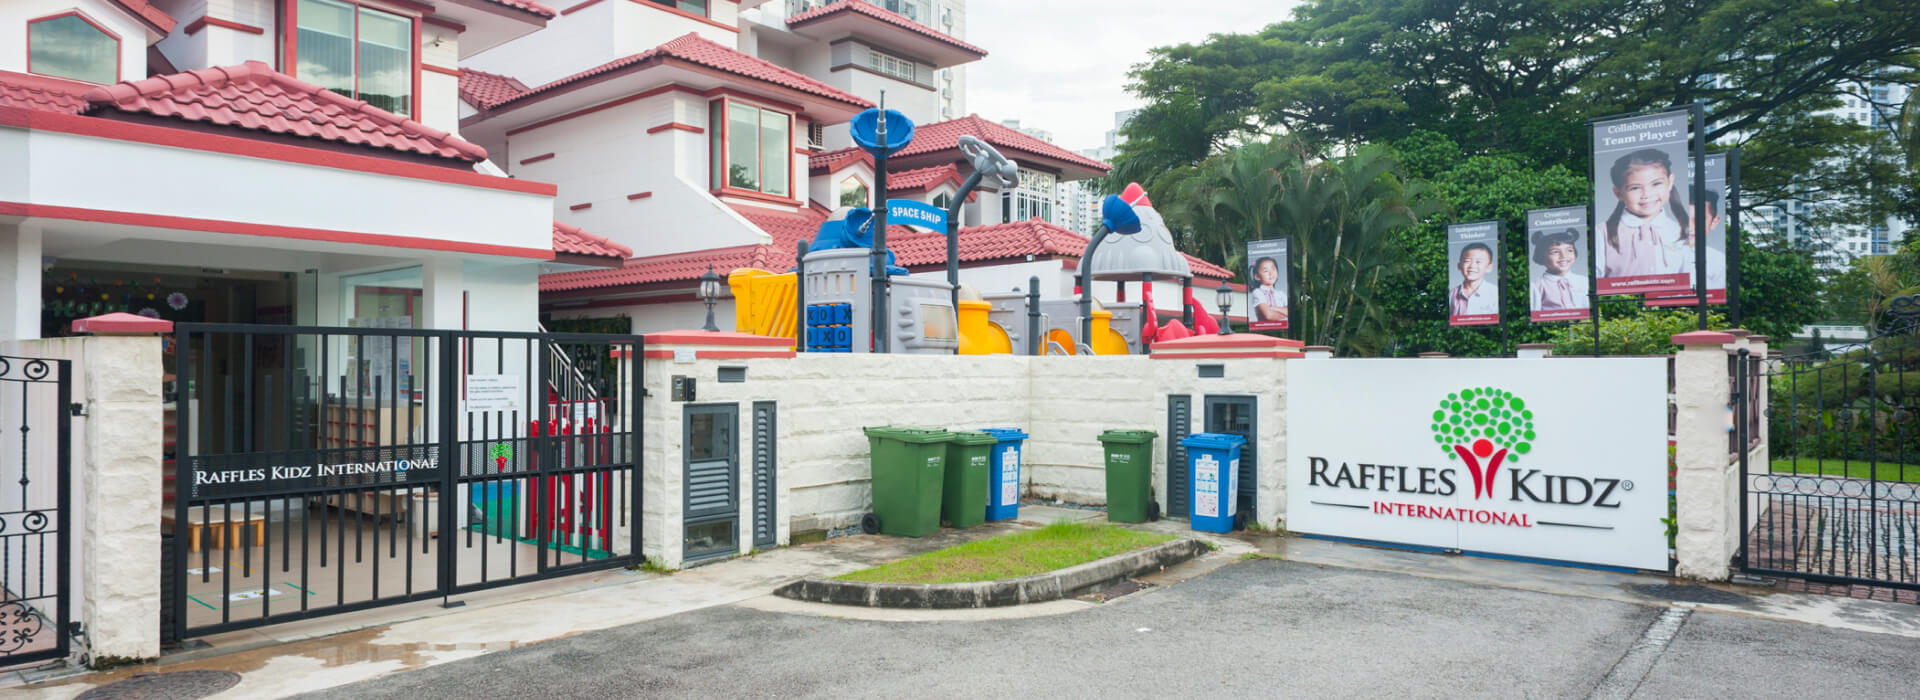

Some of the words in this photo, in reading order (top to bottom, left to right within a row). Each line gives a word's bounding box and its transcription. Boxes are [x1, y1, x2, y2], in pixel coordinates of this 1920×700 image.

[1608, 119, 1673, 134] Collaborative
[1602, 136, 1636, 146] Team
[1640, 129, 1678, 142] Player
[892, 206, 919, 219] SPACE
[920, 210, 941, 224] SHIP
[1535, 217, 1580, 226] Contributor
[843, 308, 852, 320] X
[824, 331, 831, 342] X
[838, 331, 846, 342] O
[196, 469, 265, 485] RAFFLES
[271, 465, 312, 480] KIDZ
[317, 456, 438, 476] INTERNATIONAL
[1308, 456, 1457, 496] RAFFLES
[1373, 501, 1532, 528] INTERNATIONAL
